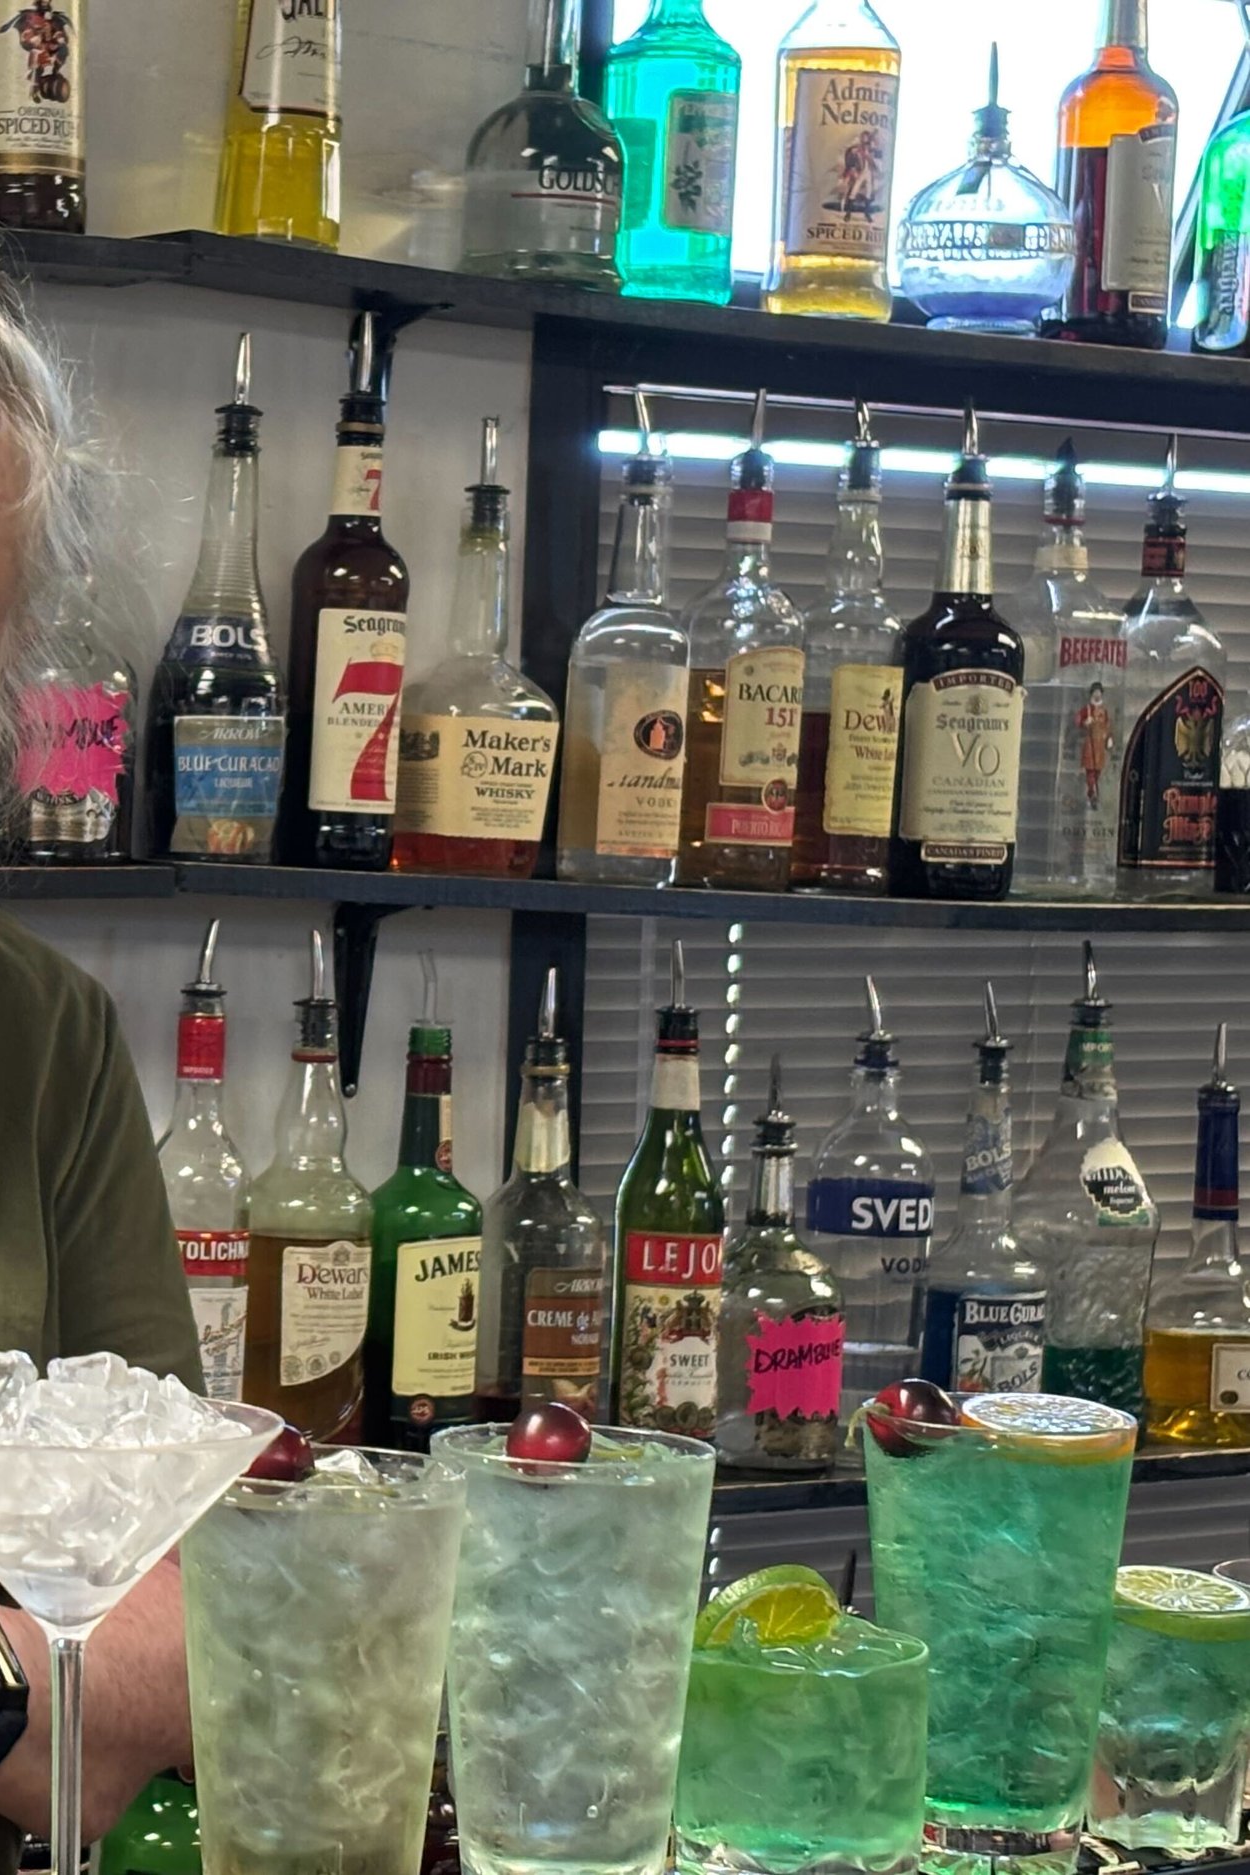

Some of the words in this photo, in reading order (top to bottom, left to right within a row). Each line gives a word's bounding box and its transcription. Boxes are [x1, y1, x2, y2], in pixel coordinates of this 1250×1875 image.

[819, 102, 888, 128] Nelson
[806, 227, 863, 242] SPICED
[190, 624, 268, 651] BOLS
[939, 674, 1013, 691] IMPORTED
[1189, 680, 1209, 698] 100
[935, 712, 1010, 734] Seagram's
[201, 726, 269, 741] ARROW
[462, 728, 552, 753] Maker's
[178, 755, 212, 772] BLUE
[488, 756, 548, 778] Mark
[932, 776, 1005, 788] CANADIAN
[474, 787, 536, 799] WHISKY
[965, 1142, 1012, 1172] BOLS
[1103, 1181, 1136, 1195] melon
[527, 1309, 574, 1328] CREME
[576, 1311, 590, 1328] de
[964, 1301, 1009, 1324] BLUE
[669, 1353, 710, 1368] SWEET
